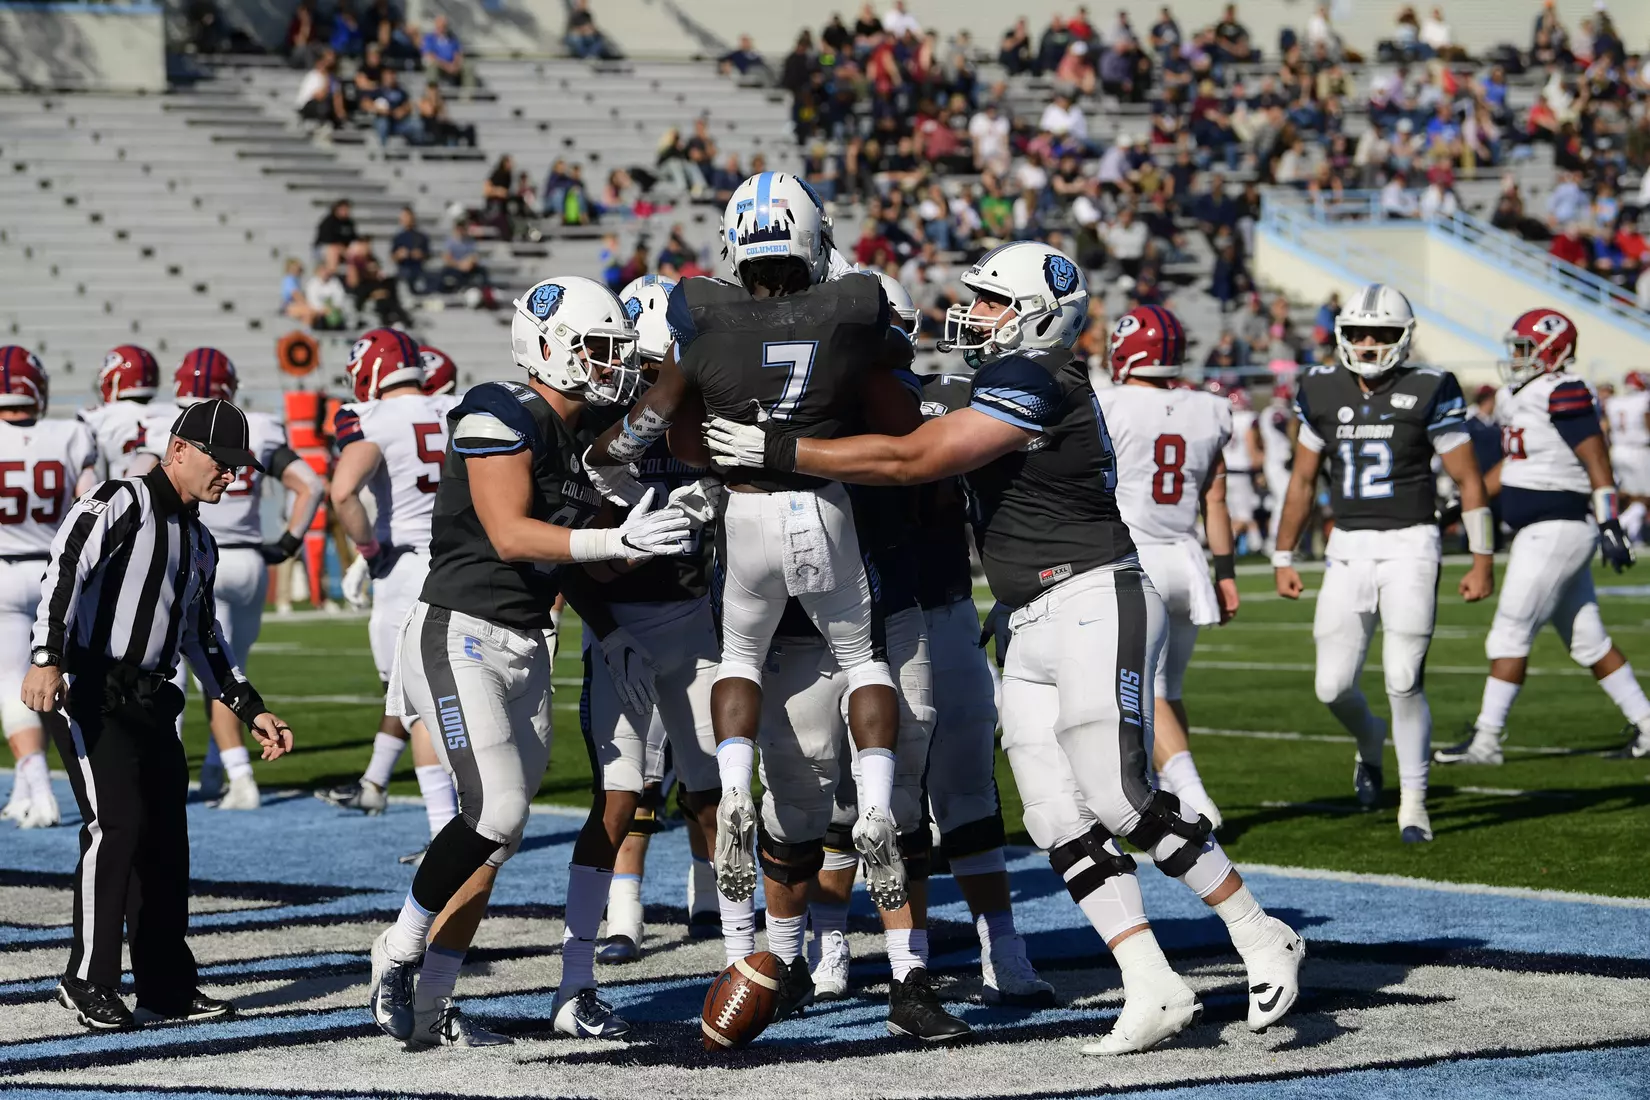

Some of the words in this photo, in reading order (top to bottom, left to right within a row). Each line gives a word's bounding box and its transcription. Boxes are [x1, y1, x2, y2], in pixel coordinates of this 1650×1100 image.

[746, 245, 788, 256] COLUMBIA
[1117, 318, 1134, 333] P
[761, 340, 820, 421] 7
[412, 422, 447, 494] 5
[1336, 424, 1395, 440] COLUMBIA
[0, 460, 64, 525] 59
[562, 480, 603, 508] COLUMBIA
[1152, 433, 1187, 506] 8
[1337, 440, 1395, 499] 12
[1054, 566, 1069, 575] XXL
[463, 636, 484, 662] C
[437, 694, 468, 750] LIONS
[1120, 667, 1142, 728] LIONS
